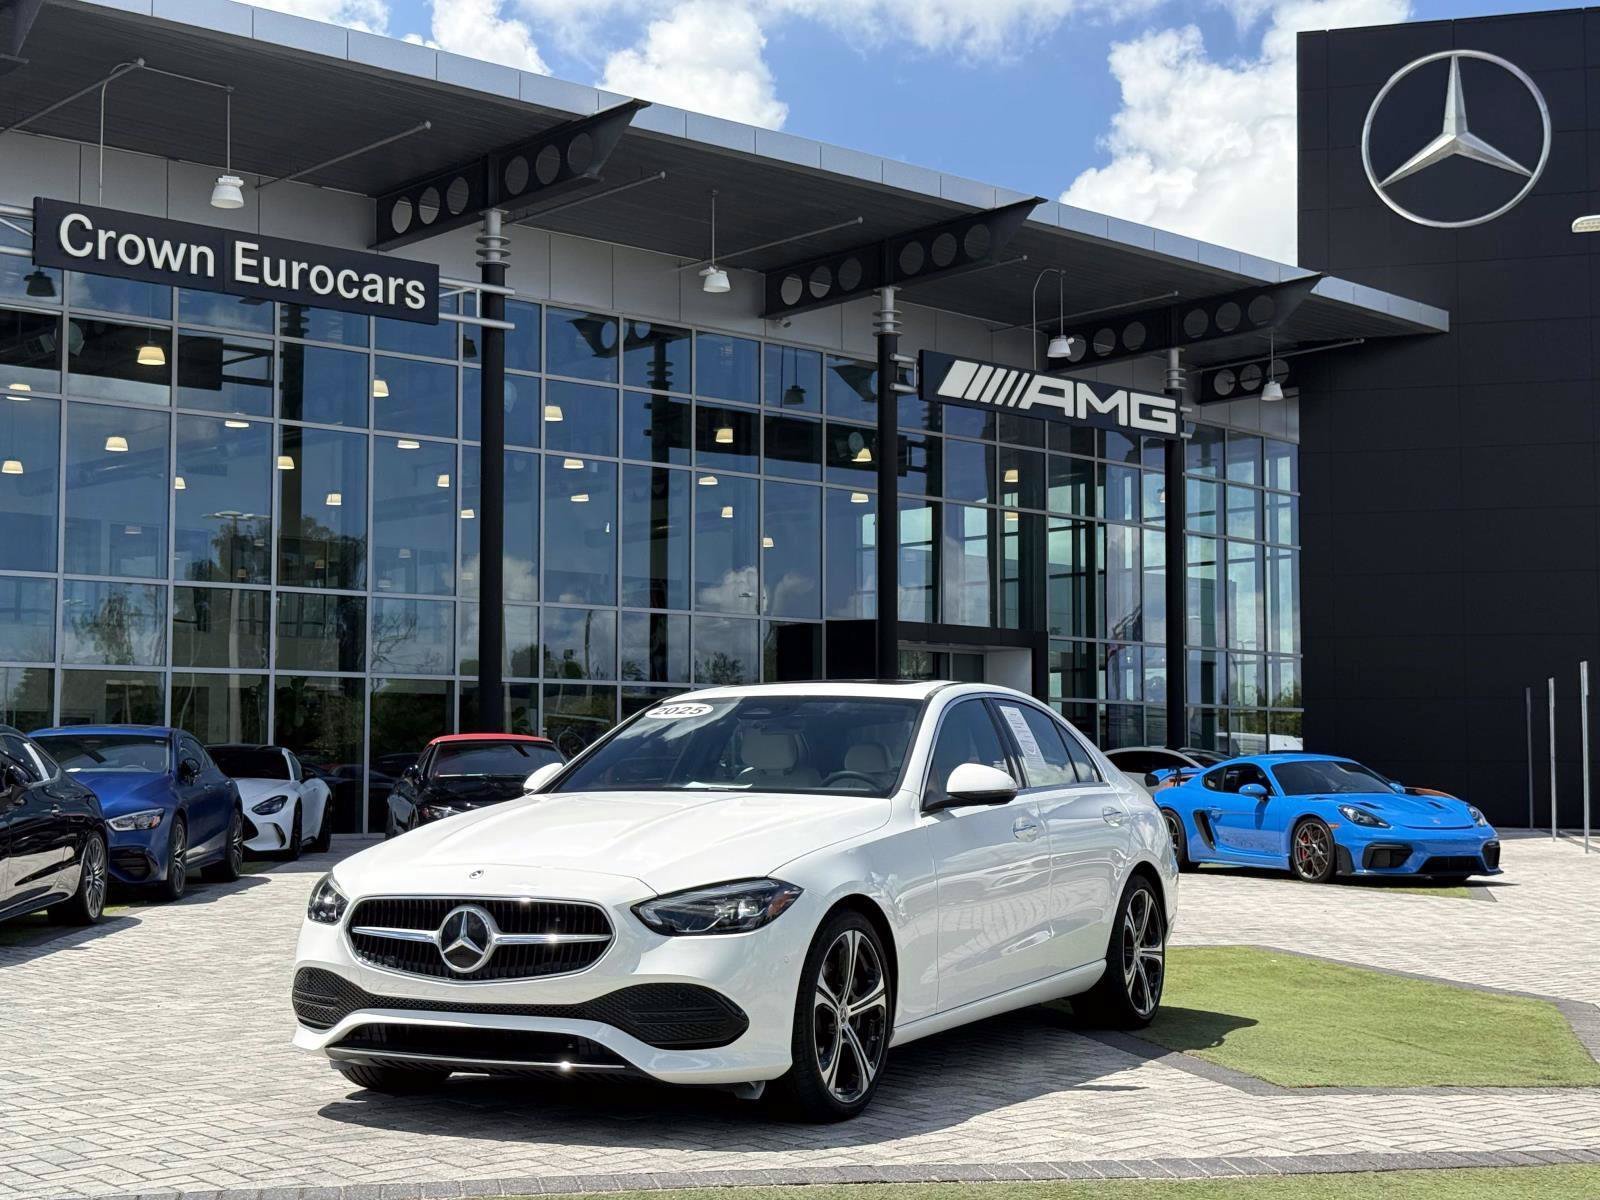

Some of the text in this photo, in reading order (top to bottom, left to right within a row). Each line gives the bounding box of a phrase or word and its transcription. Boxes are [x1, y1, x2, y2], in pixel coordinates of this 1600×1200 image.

[59, 213, 426, 310] Crown Eurocars
[1017, 374, 1177, 434] AMG
[652, 705, 705, 716] 2025
